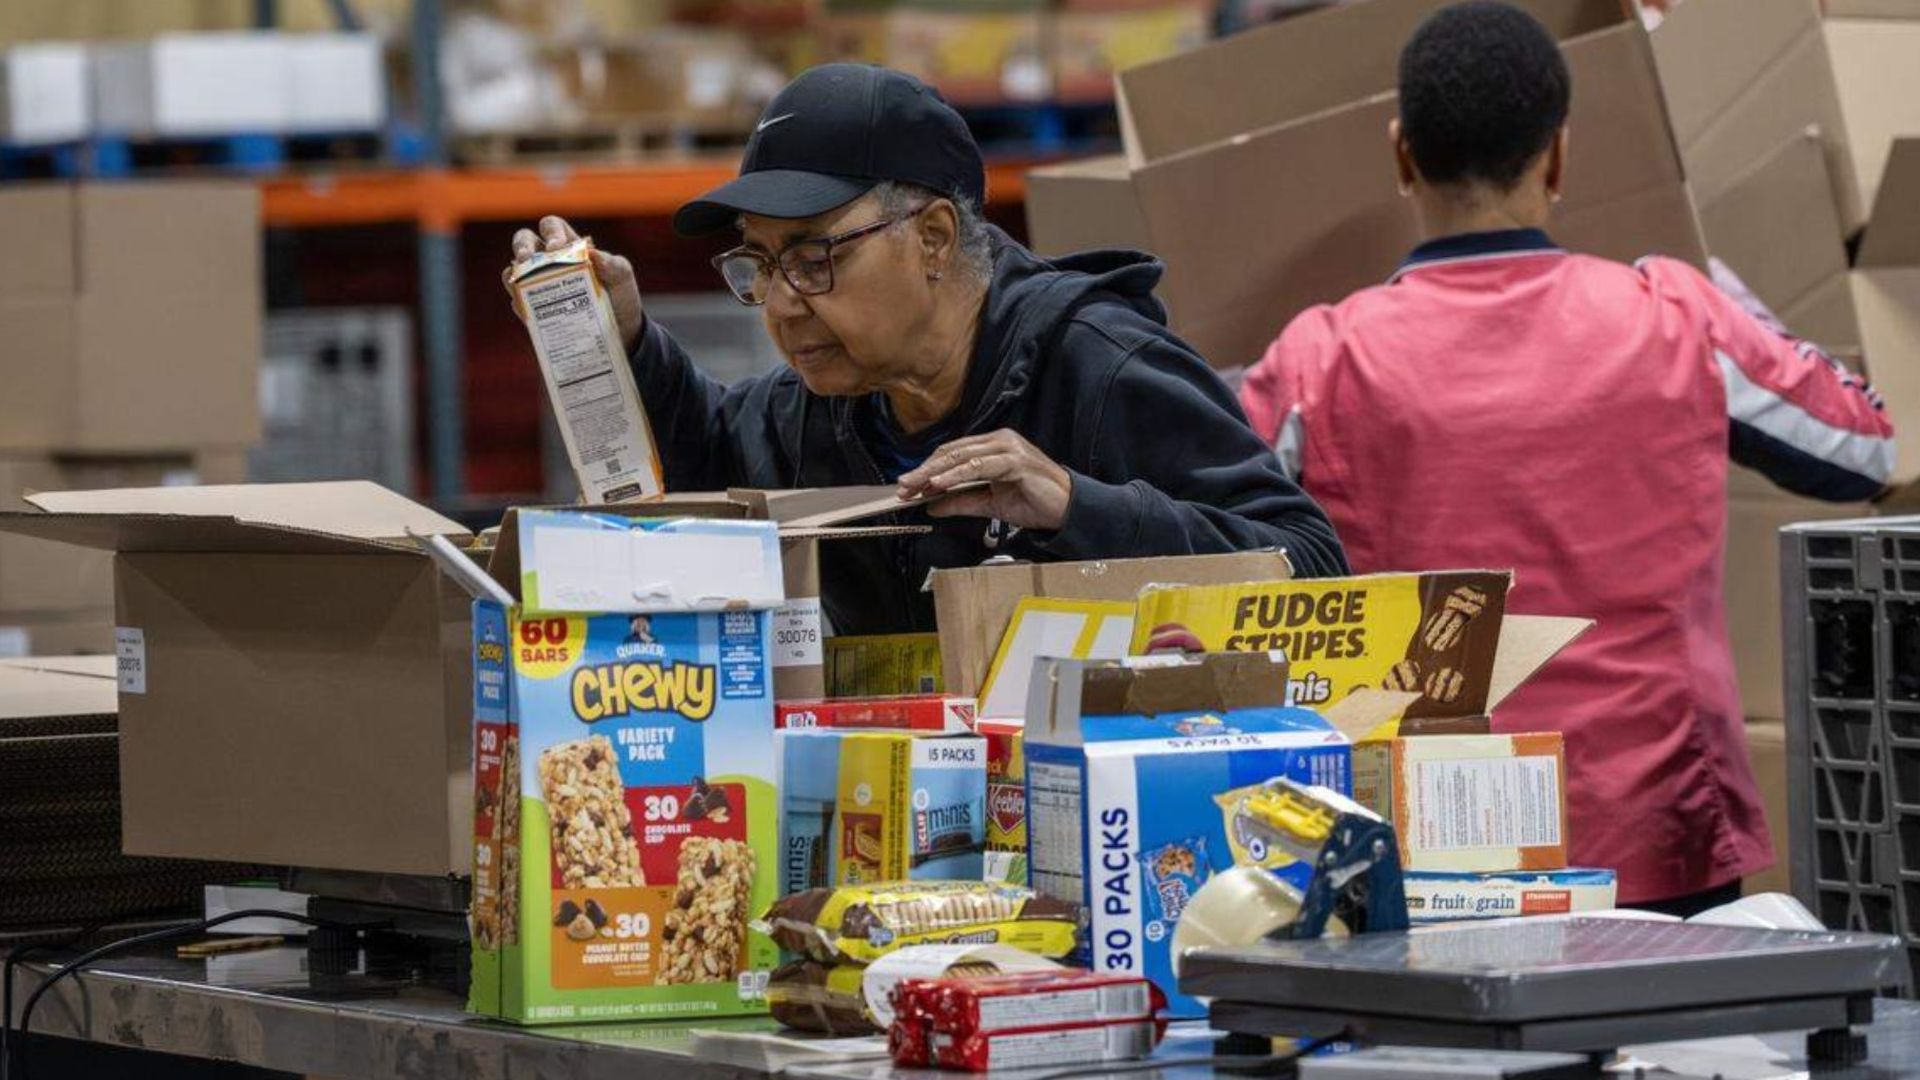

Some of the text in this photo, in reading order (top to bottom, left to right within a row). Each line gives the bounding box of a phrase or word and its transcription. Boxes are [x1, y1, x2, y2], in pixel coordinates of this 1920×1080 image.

[1233, 590, 1367, 631] FUDGE
[521, 616, 568, 646] 60
[776, 629, 816, 645] 30076
[521, 648, 569, 662] BARS
[480, 729, 497, 751] 30
[617, 726, 675, 745] VARIETY
[628, 744, 666, 761] PACK
[928, 748, 976, 761] 15 PACKS
[644, 794, 679, 821] 30
[929, 803, 970, 830] minis
[1101, 807, 1134, 970] 30 PACKS
[614, 912, 650, 938] 30
